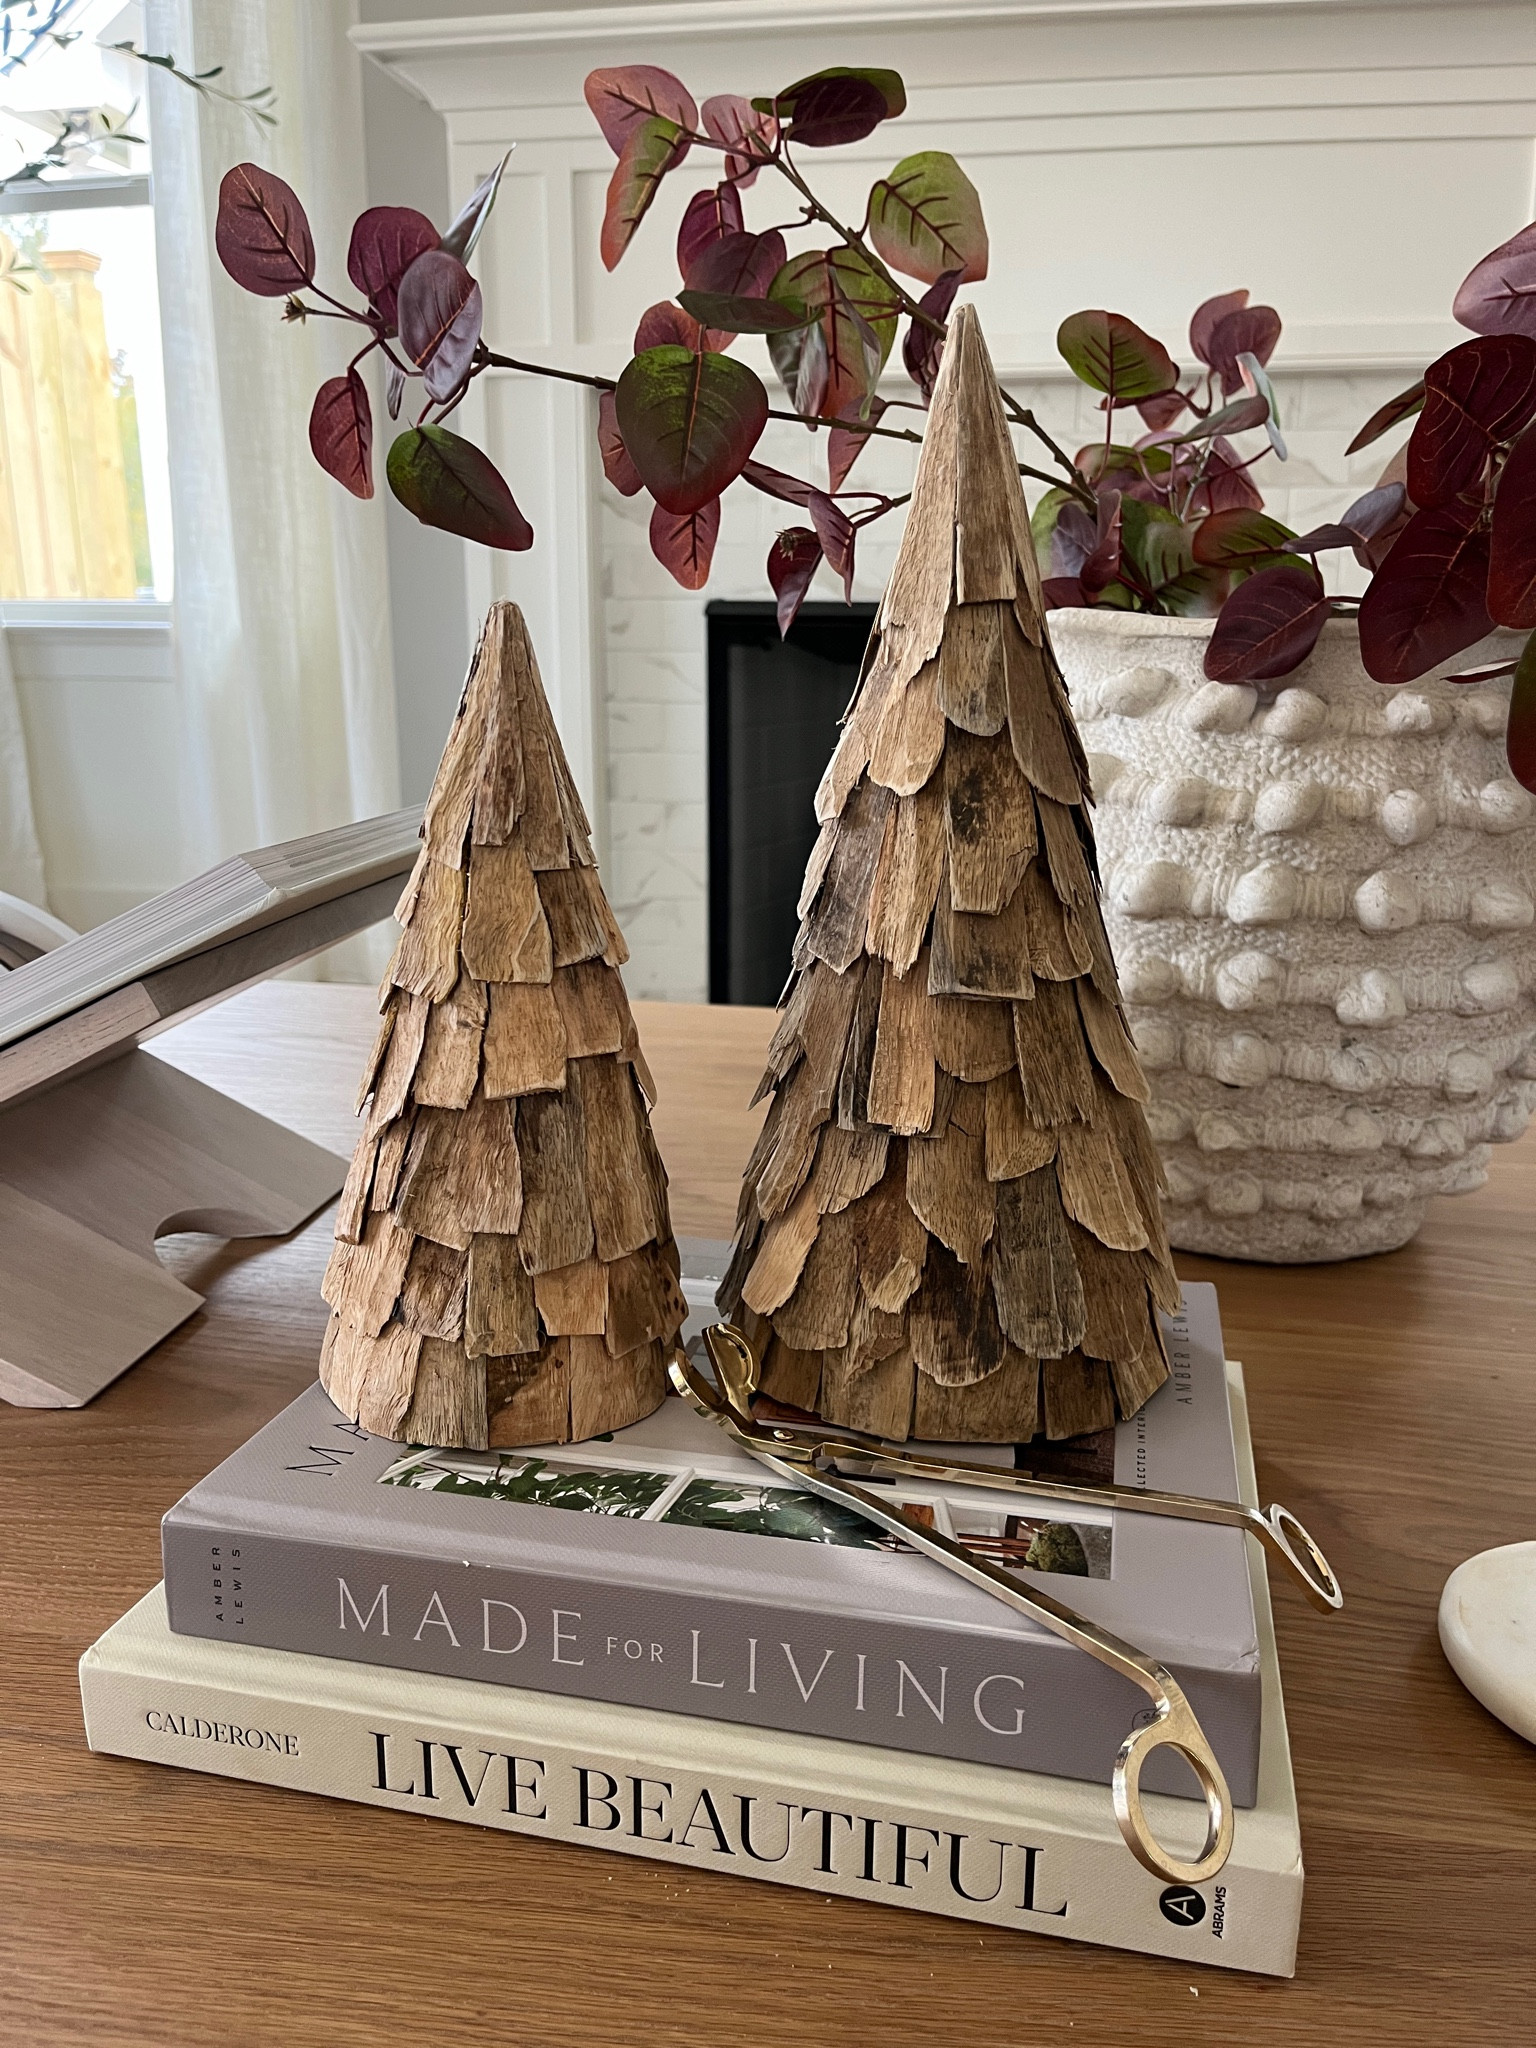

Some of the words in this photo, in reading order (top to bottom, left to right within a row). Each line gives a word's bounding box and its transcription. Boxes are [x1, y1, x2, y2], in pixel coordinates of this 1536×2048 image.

[1174, 1352, 1193, 1405] AMBER
[1136, 1448, 1146, 1489] LECTED
[211, 1547, 224, 1622] AMBER
[232, 1549, 244, 1624] LEWIS
[337, 1577, 584, 1666] MADE
[606, 1636, 664, 1663] FOR
[690, 1629, 1025, 1735] LIVING
[145, 1711, 299, 1756] CALDERONE
[368, 1731, 547, 1819] LIVE
[572, 1766, 1068, 1917] BEAUTIFUL
[1211, 1885, 1227, 1940] ABRAMS
